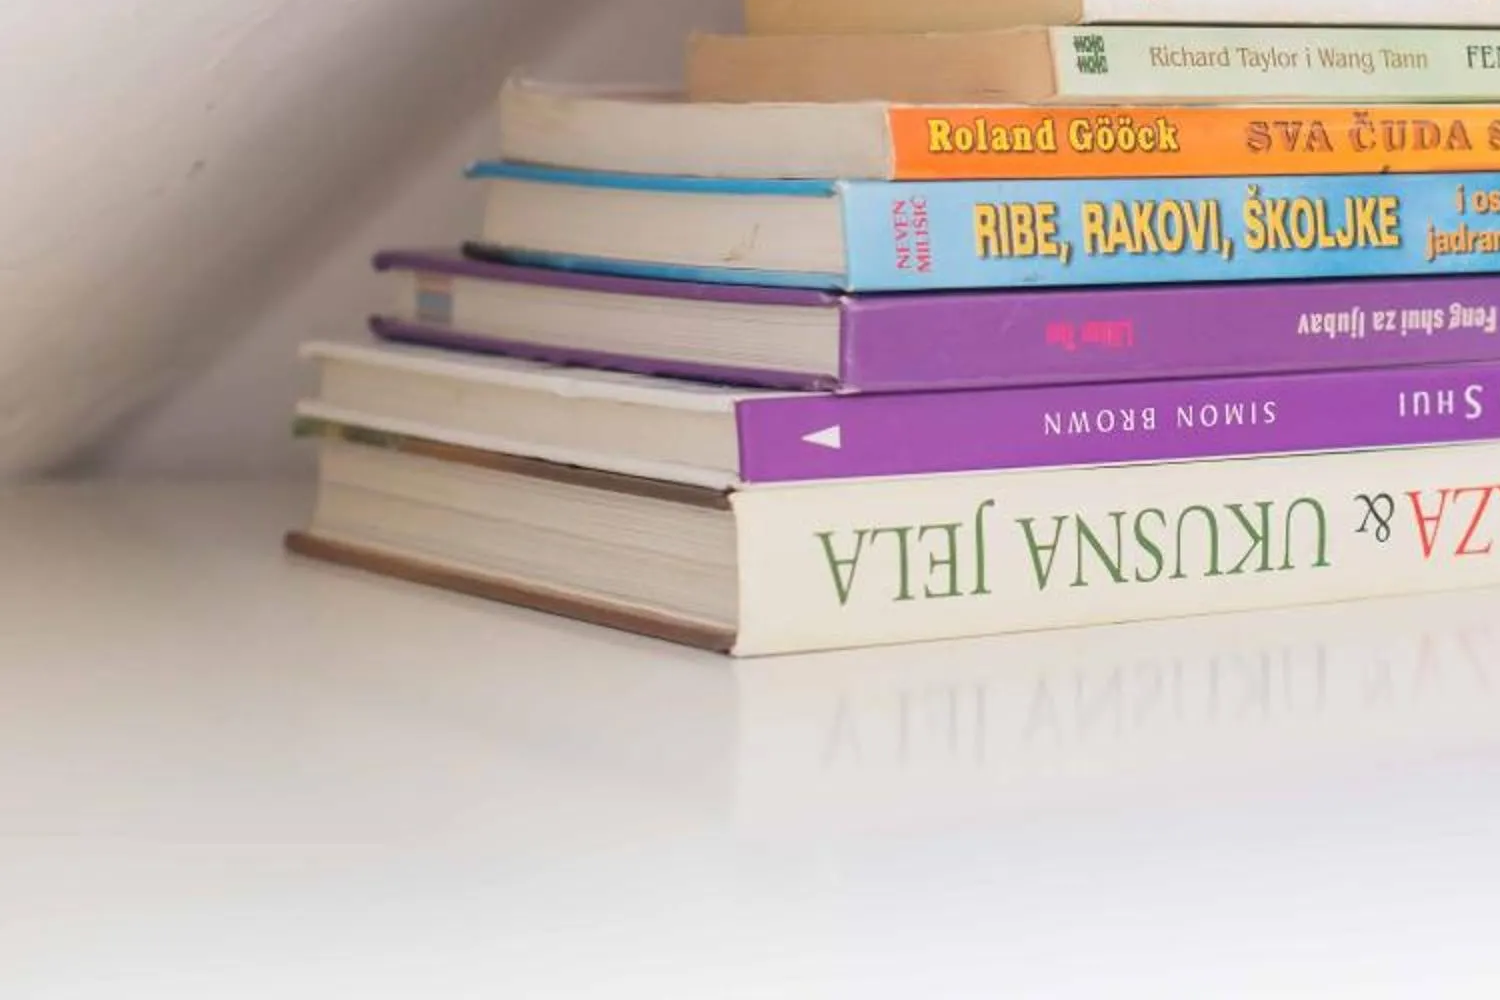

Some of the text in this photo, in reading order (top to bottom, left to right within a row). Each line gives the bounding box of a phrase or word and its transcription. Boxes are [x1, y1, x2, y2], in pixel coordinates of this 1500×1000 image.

[1150, 46, 1427, 73] Richard Taylor i Wang Tann
[928, 114, 1180, 155] Roland Gööck
[1247, 120, 1333, 153] SVA
[1348, 111, 1473, 153] ČUDA
[1455, 185, 1466, 214] i
[892, 200, 911, 269] NEVEN
[975, 186, 1403, 266] RIBE, RAKOVI, ŠKOLJKE
[1298, 303, 1496, 339] Feng shui za ljubav
[1045, 402, 1275, 434] SIMON BROWN
[1400, 385, 1482, 418] SHUI
[1355, 493, 1394, 542] &
[816, 499, 995, 605] JELA
[1016, 498, 1329, 590] UKUSNA
